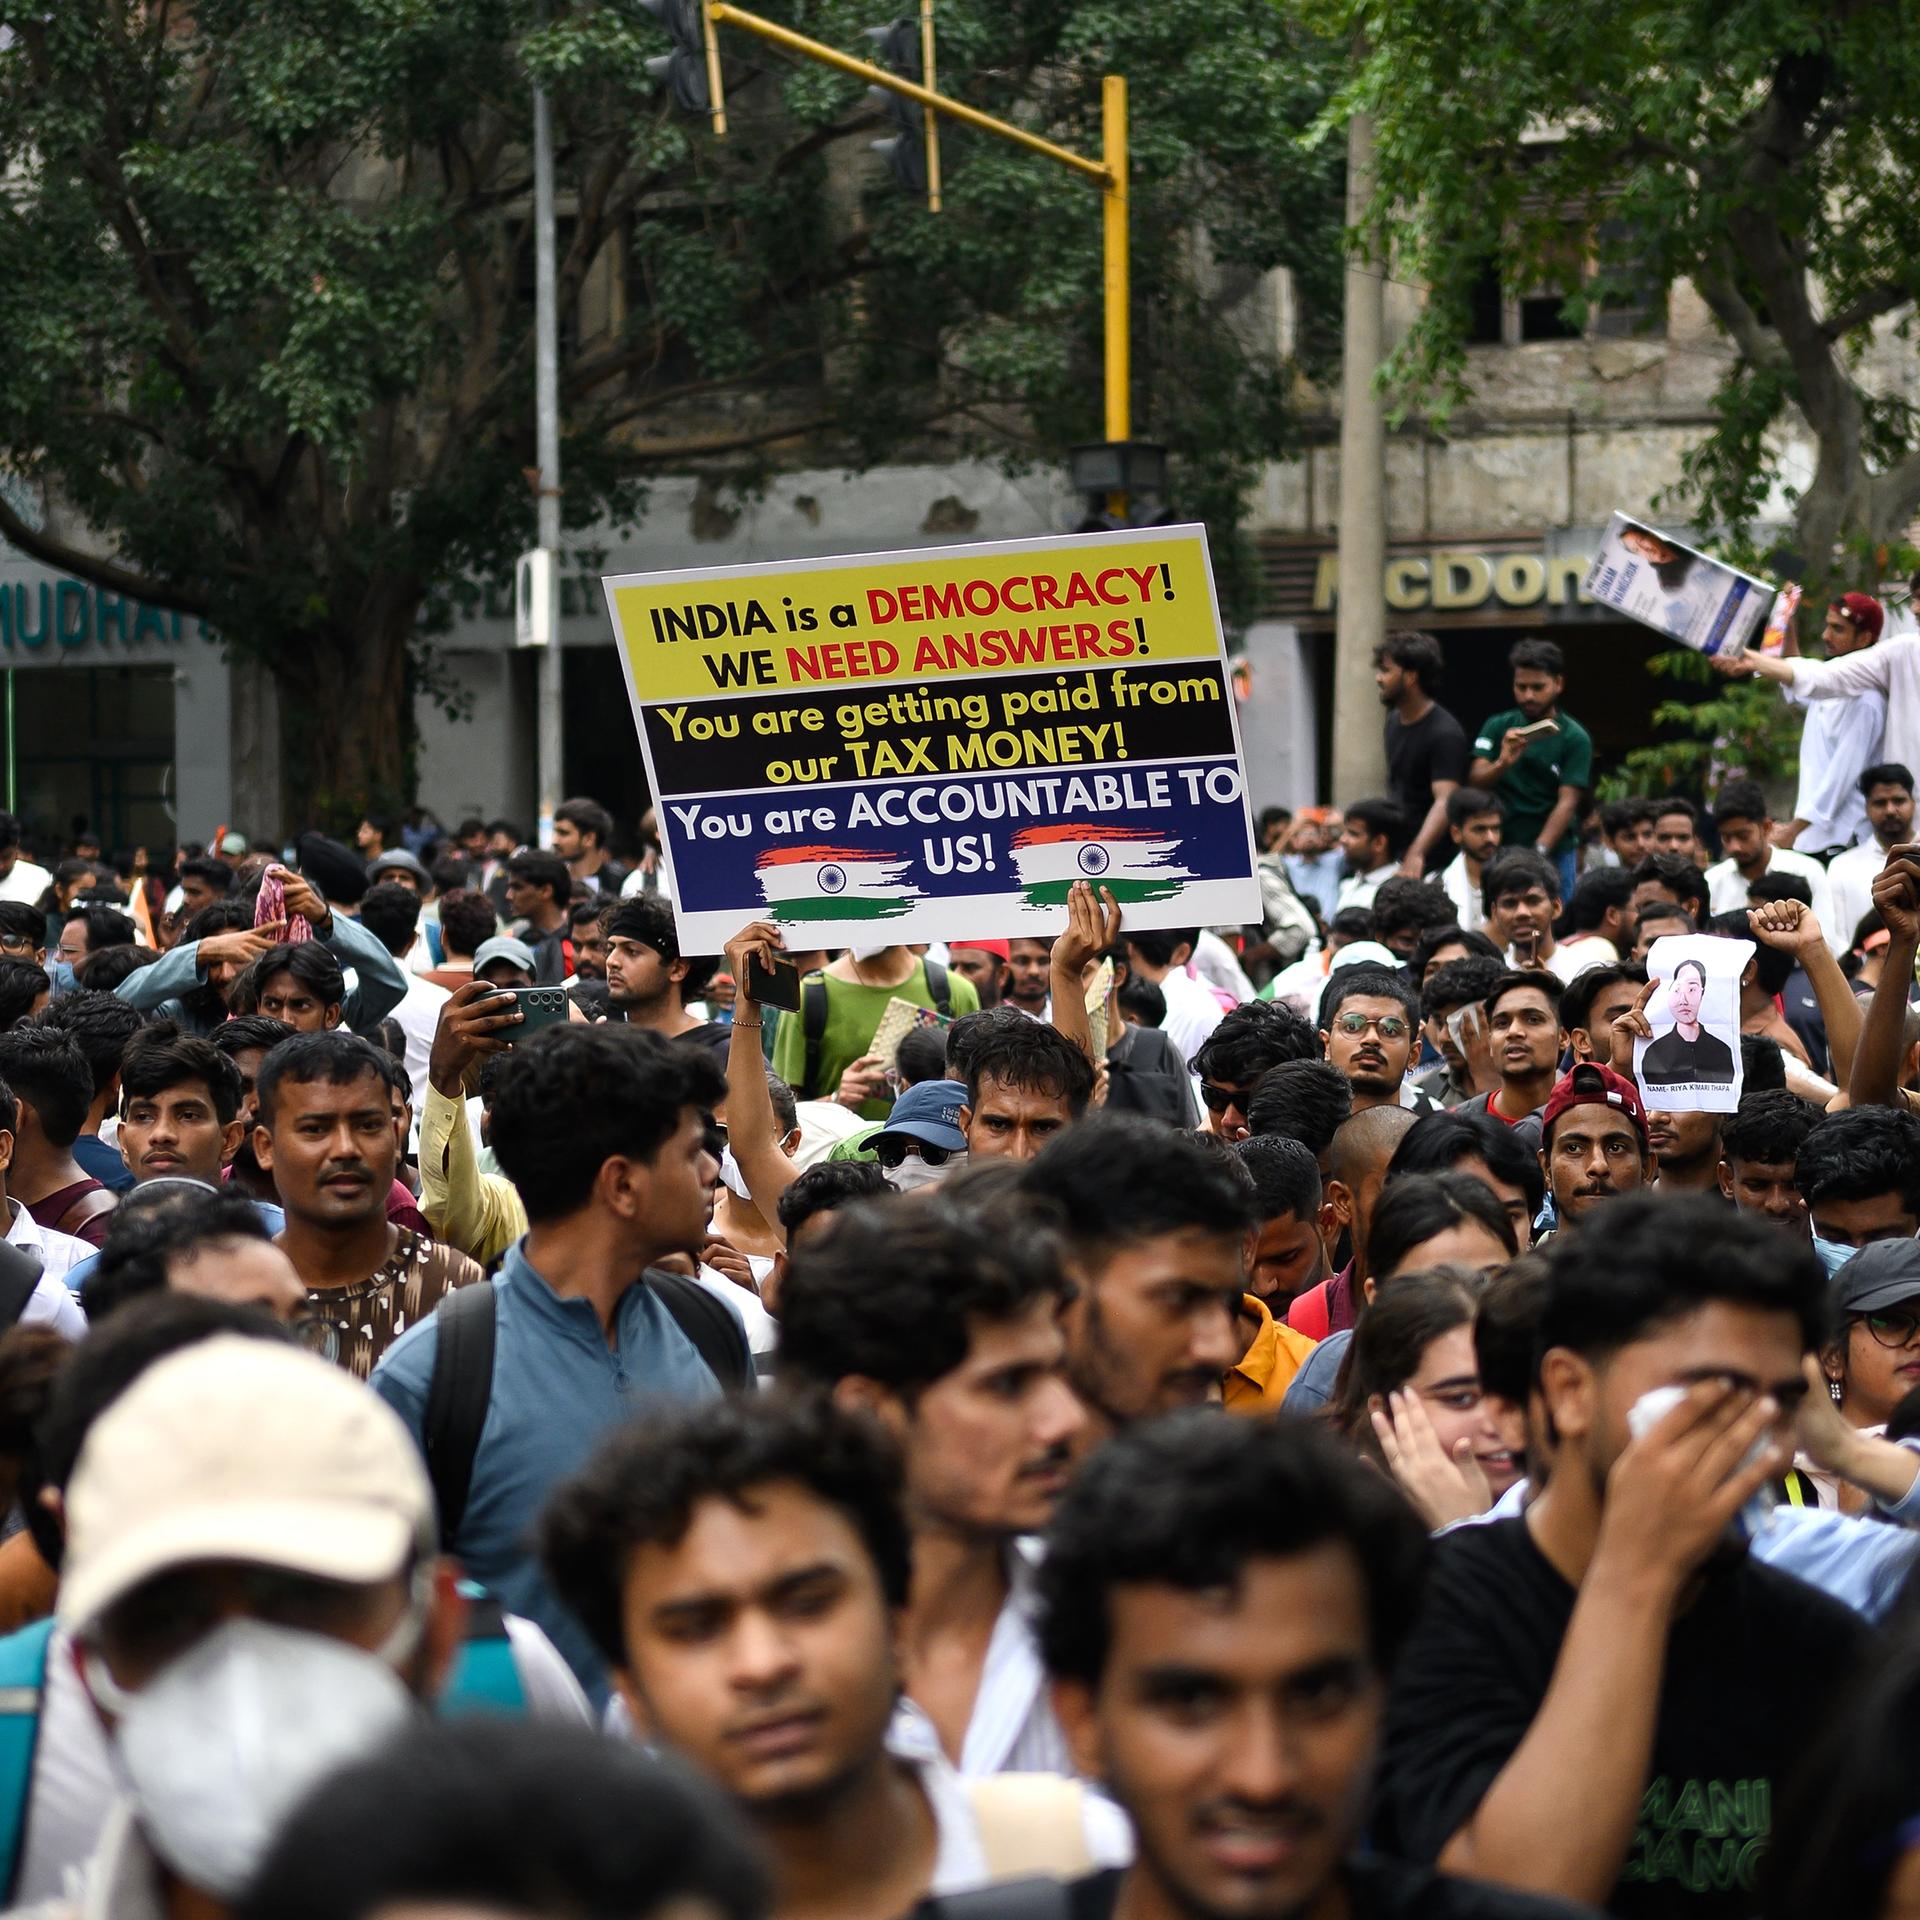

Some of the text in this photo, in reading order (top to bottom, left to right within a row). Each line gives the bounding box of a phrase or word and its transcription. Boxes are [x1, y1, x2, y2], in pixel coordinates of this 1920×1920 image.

[650, 599, 777, 643] INDIA
[782, 597, 818, 632] is
[829, 604, 857, 628] a
[866, 563, 1175, 625] DEMOCRACY!
[702, 617, 1150, 688] WE NEED ANSWERS!
[656, 669, 1220, 742] You are getting paid from
[765, 721, 1128, 784] our TAX MONEY!
[670, 766, 1243, 840] You are ACCOUNTABLE TO
[923, 833, 996, 875] US!
[1670, 1084, 1688, 1093] RIYA
[1711, 1084, 1730, 1092] THAPA
